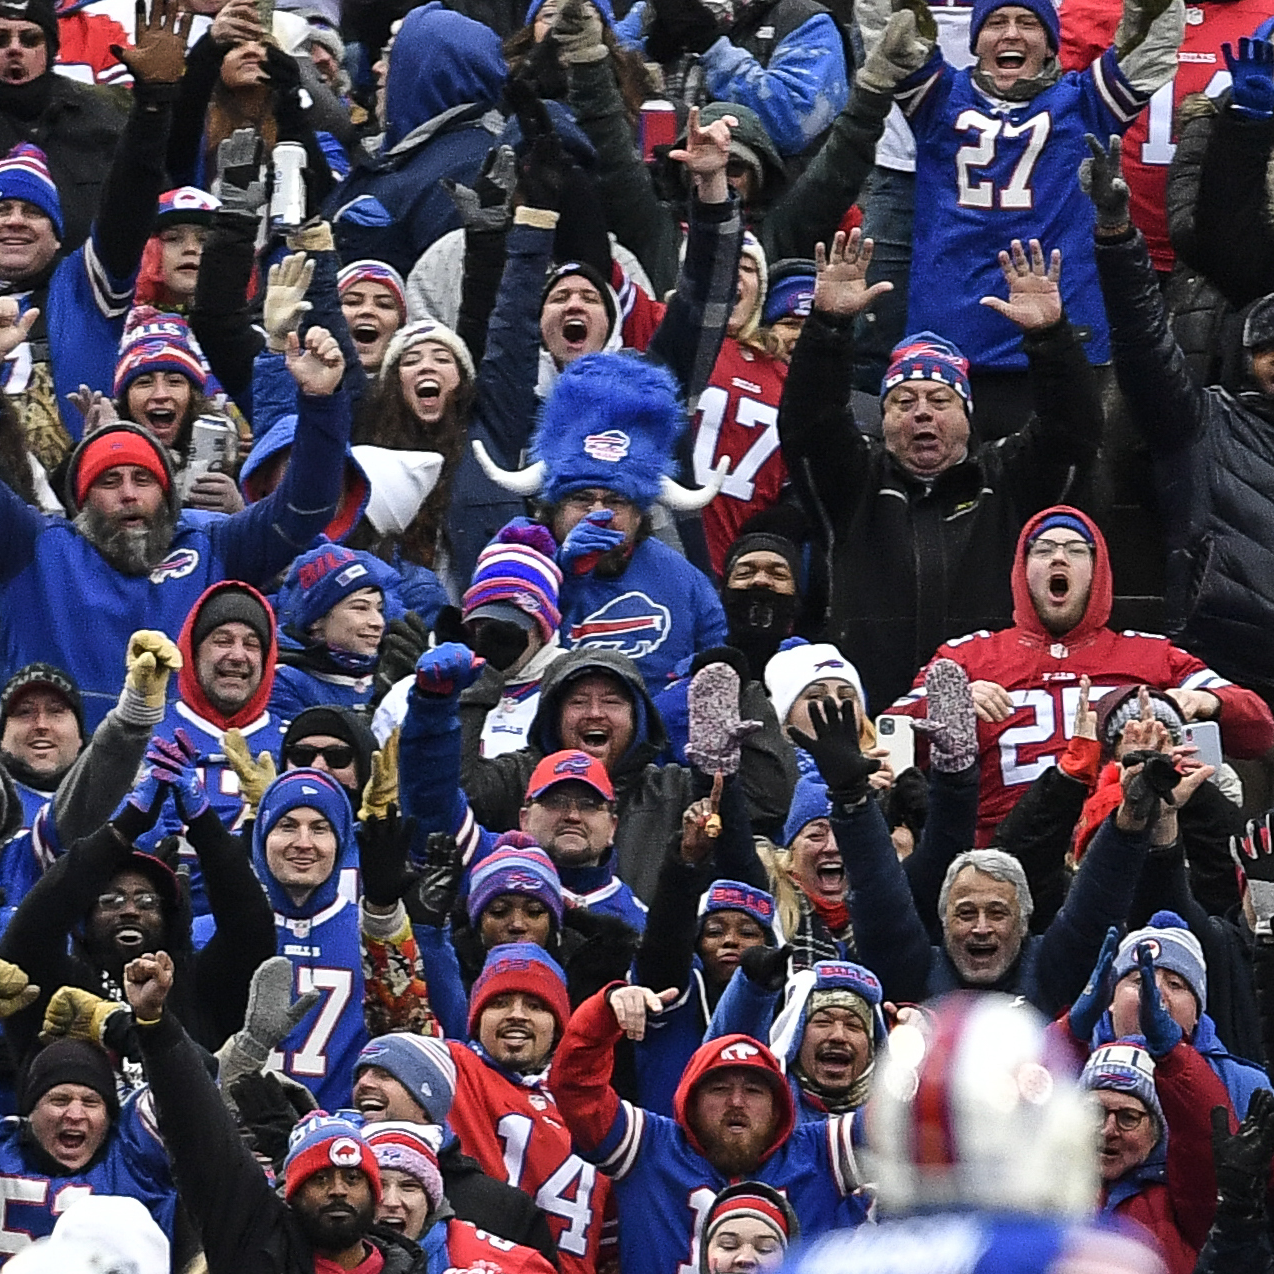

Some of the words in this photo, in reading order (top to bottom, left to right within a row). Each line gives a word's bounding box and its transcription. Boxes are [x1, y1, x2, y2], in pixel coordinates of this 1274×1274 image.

[954, 110, 1051, 209] 27
[1141, 71, 1231, 166] 1
[691, 385, 784, 503] 17
[497, 1111, 599, 1256] 14
